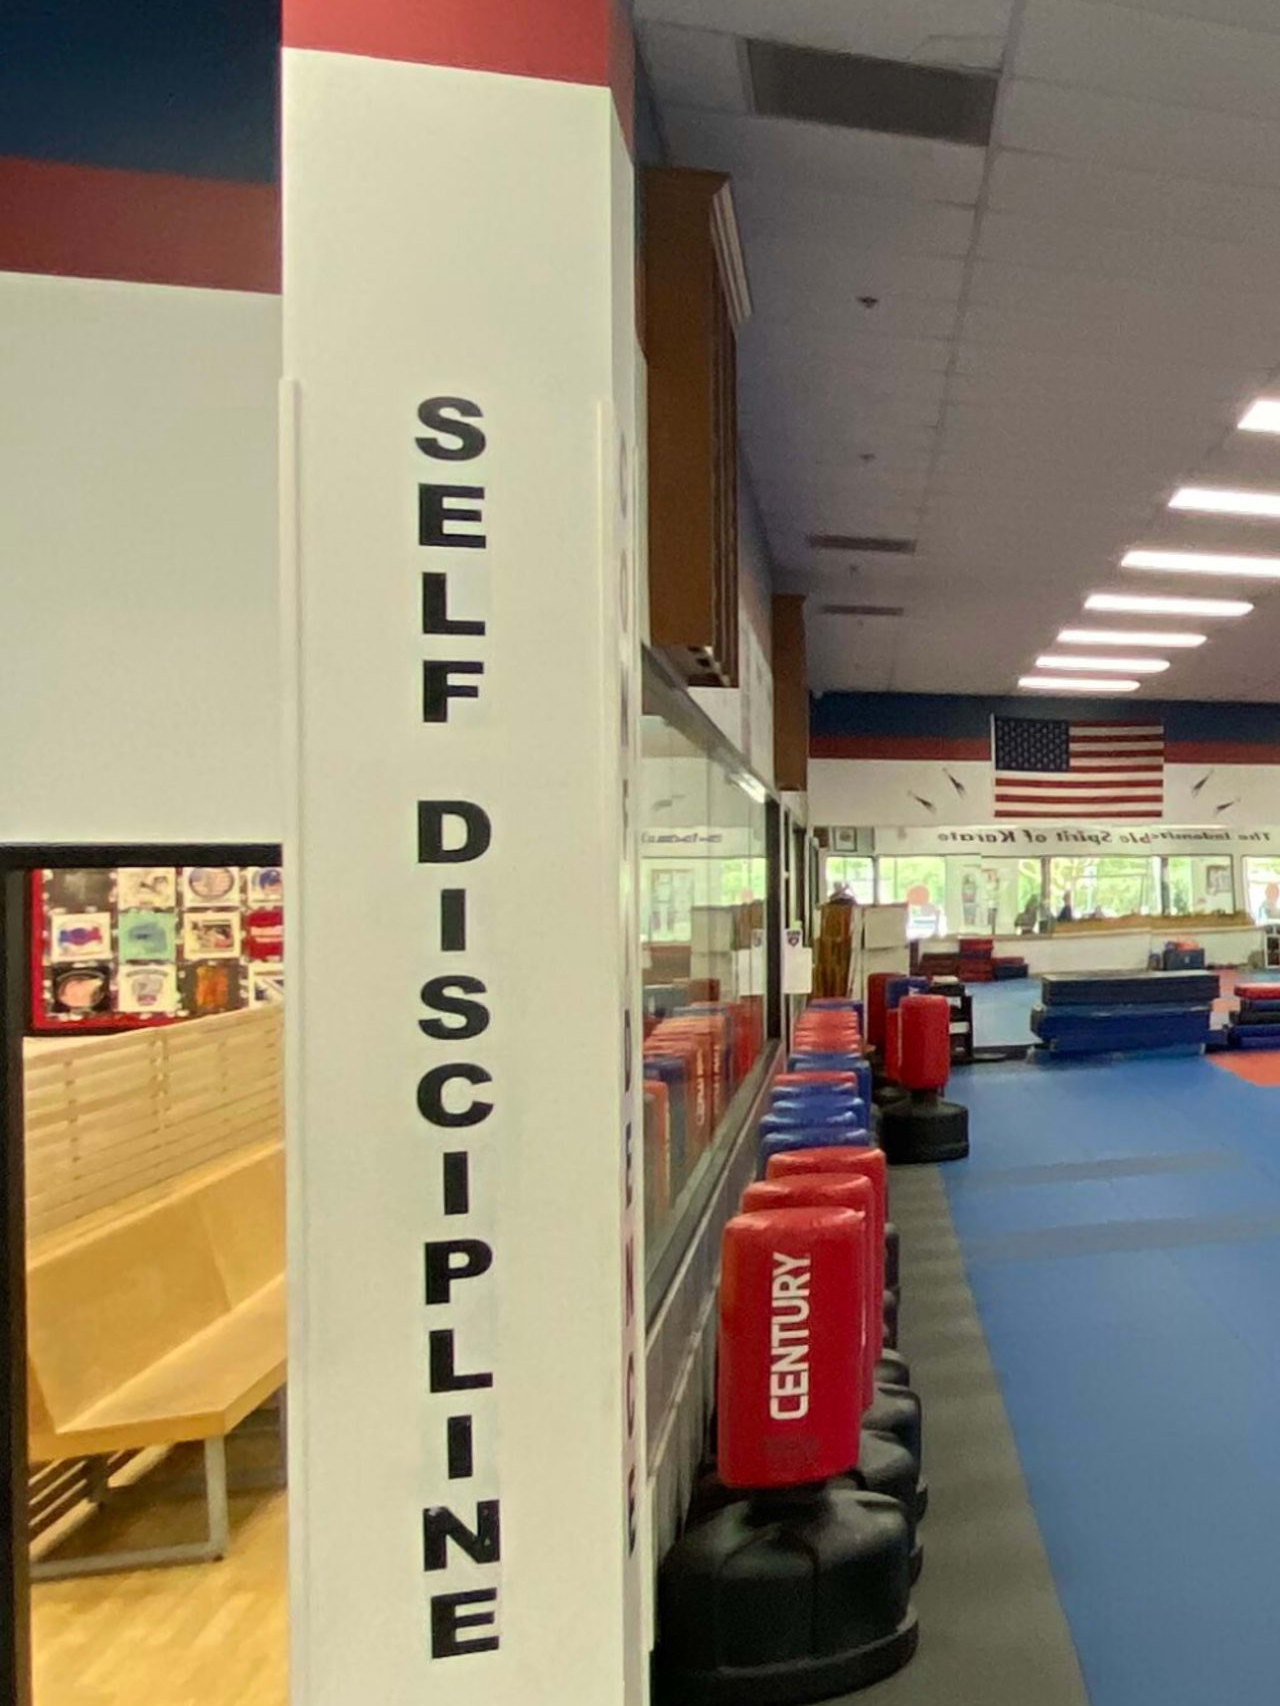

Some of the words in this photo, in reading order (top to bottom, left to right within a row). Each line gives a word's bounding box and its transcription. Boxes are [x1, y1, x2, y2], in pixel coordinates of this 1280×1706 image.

[414, 395, 487, 723] SELF
[414, 799, 501, 1661] DISCIPLINE
[769, 1251, 811, 1421] CENTURY
